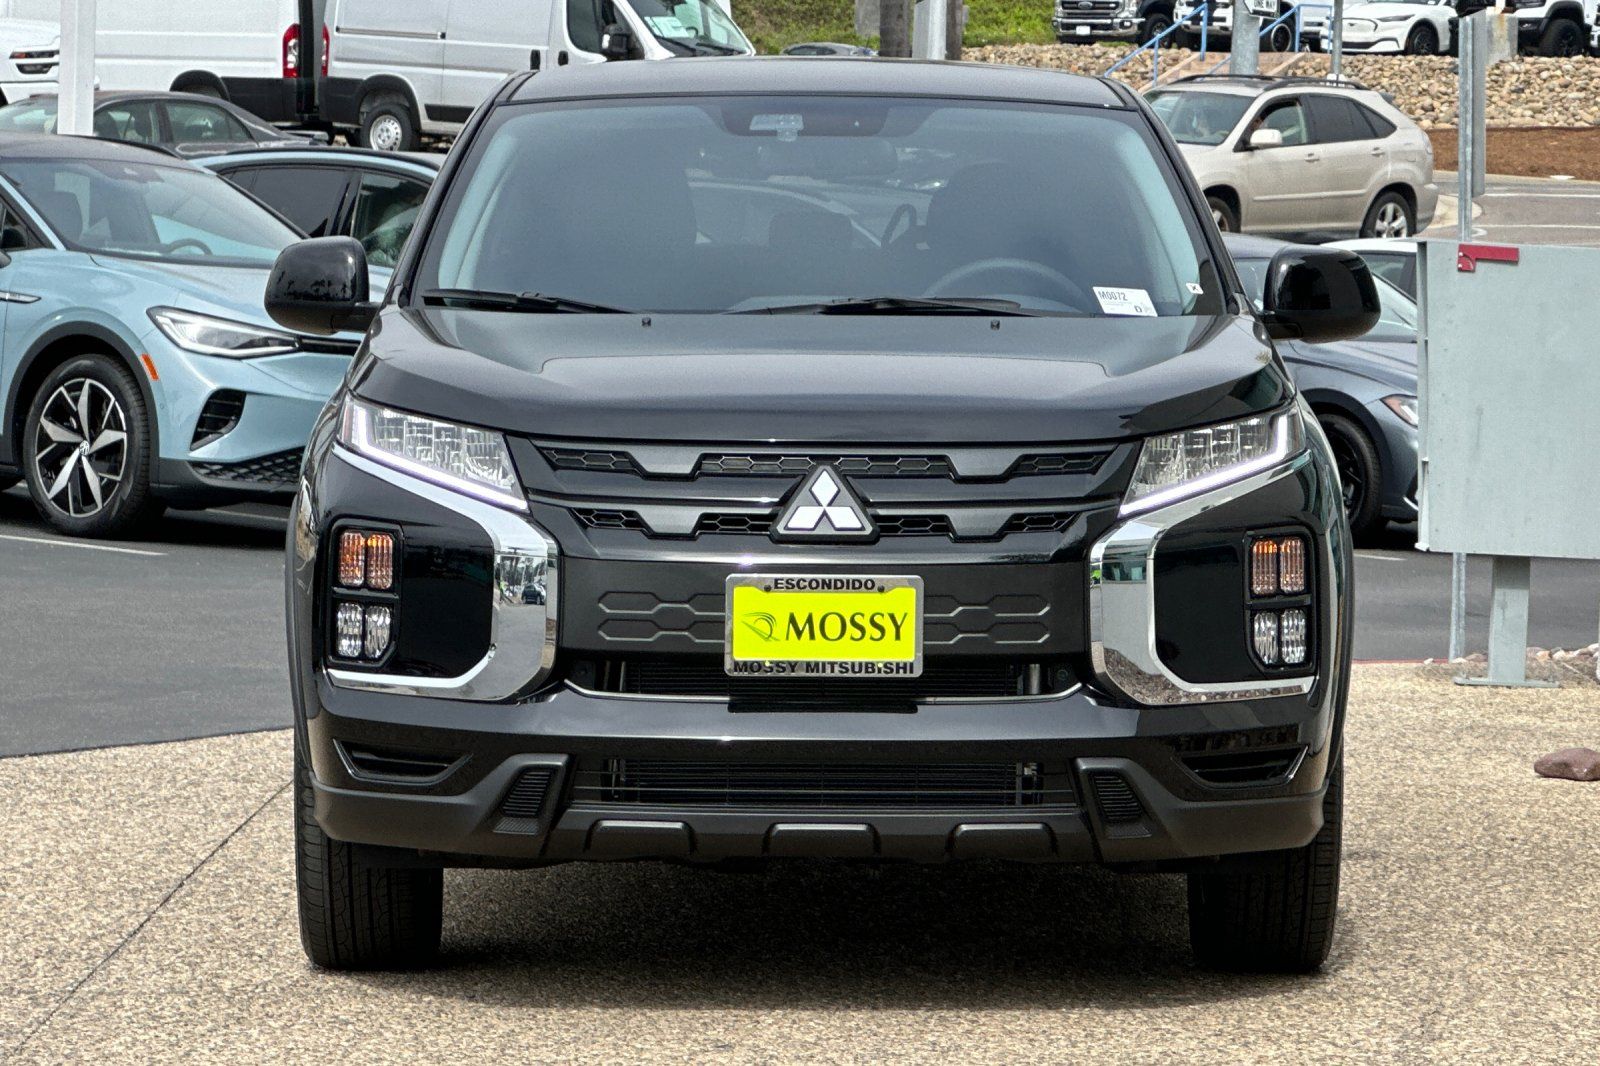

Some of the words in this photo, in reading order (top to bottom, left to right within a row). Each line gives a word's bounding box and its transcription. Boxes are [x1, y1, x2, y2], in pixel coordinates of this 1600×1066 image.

[1098, 291, 1128, 301] M0072
[773, 578, 876, 591] ESCONDIDO
[785, 612, 908, 642] MOSSY
[733, 661, 799, 675] MOSSY
[805, 661, 914, 675] MITSUBISHI
